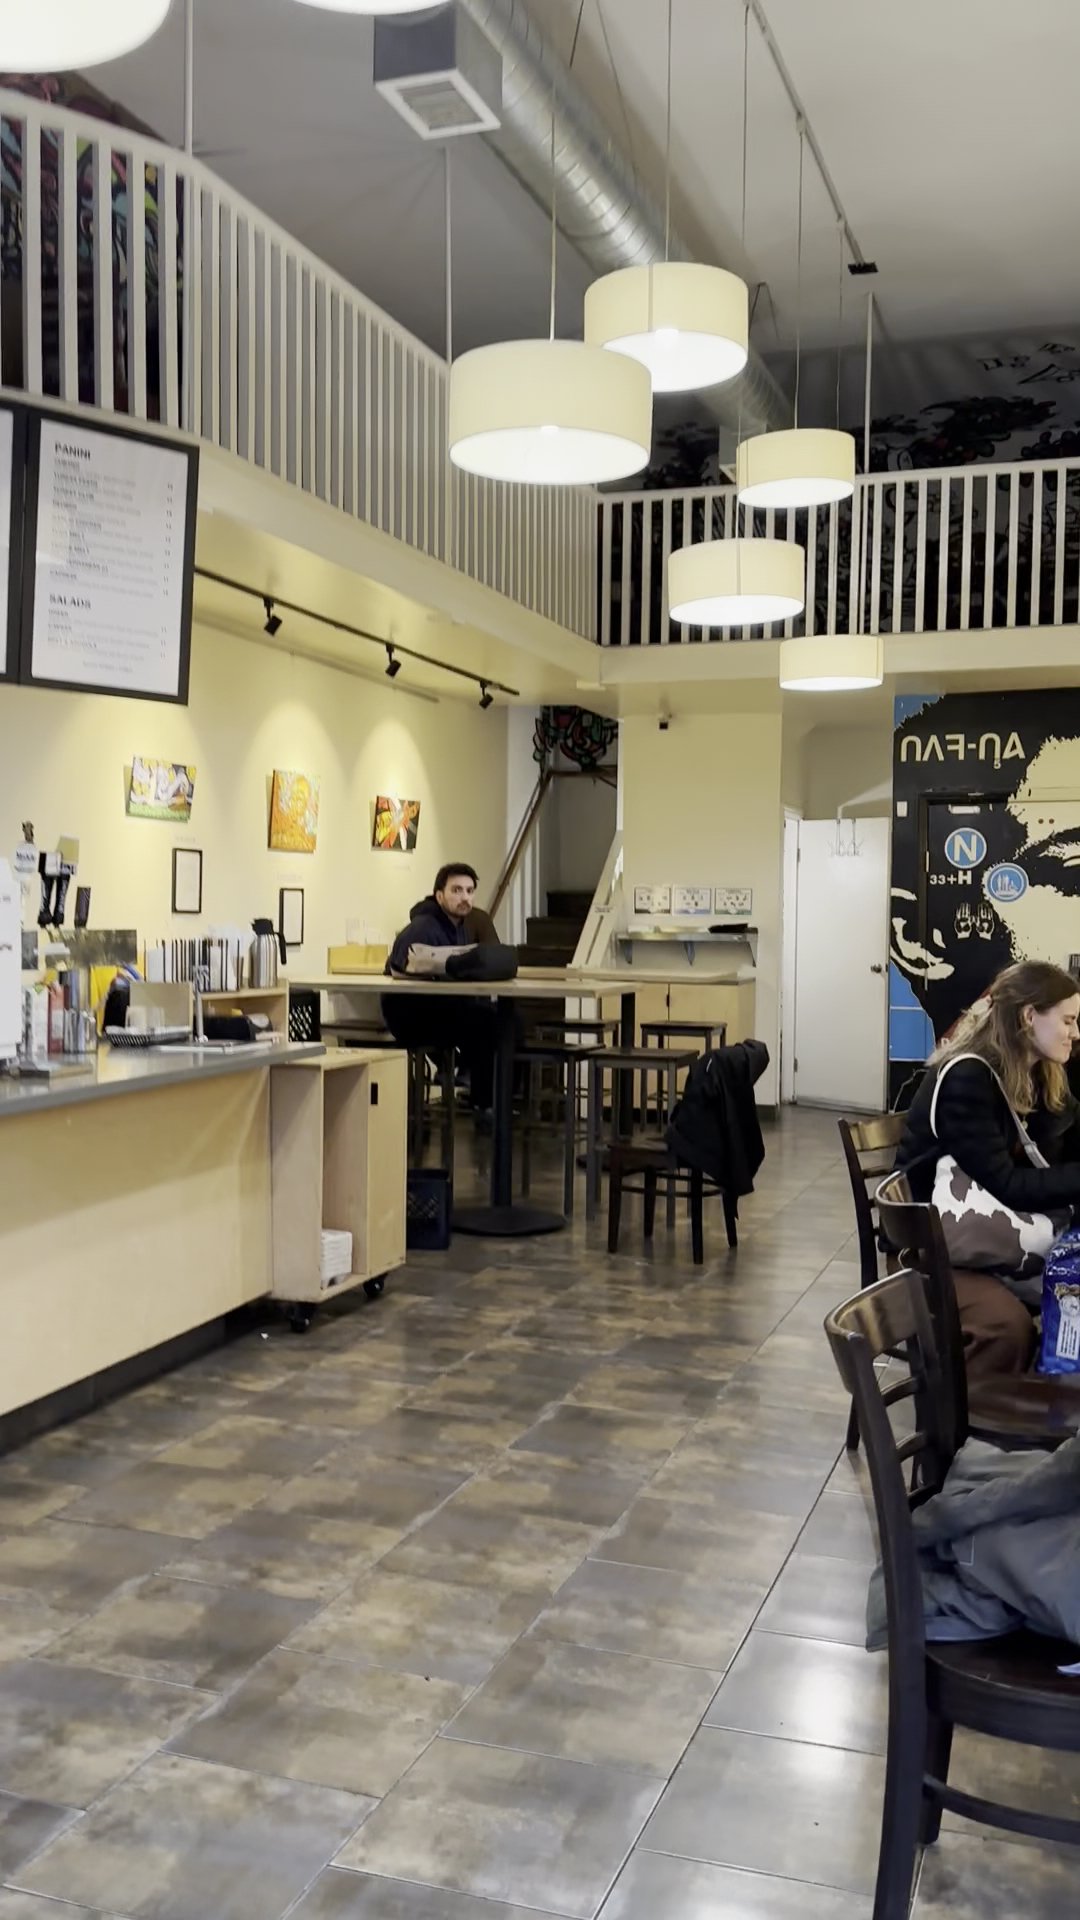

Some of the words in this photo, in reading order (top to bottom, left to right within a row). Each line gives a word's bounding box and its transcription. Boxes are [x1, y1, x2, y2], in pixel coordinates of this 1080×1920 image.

[54, 442, 91, 460] PANINI
[953, 833, 977, 862] N
[929, 870, 972, 885] 33+H
